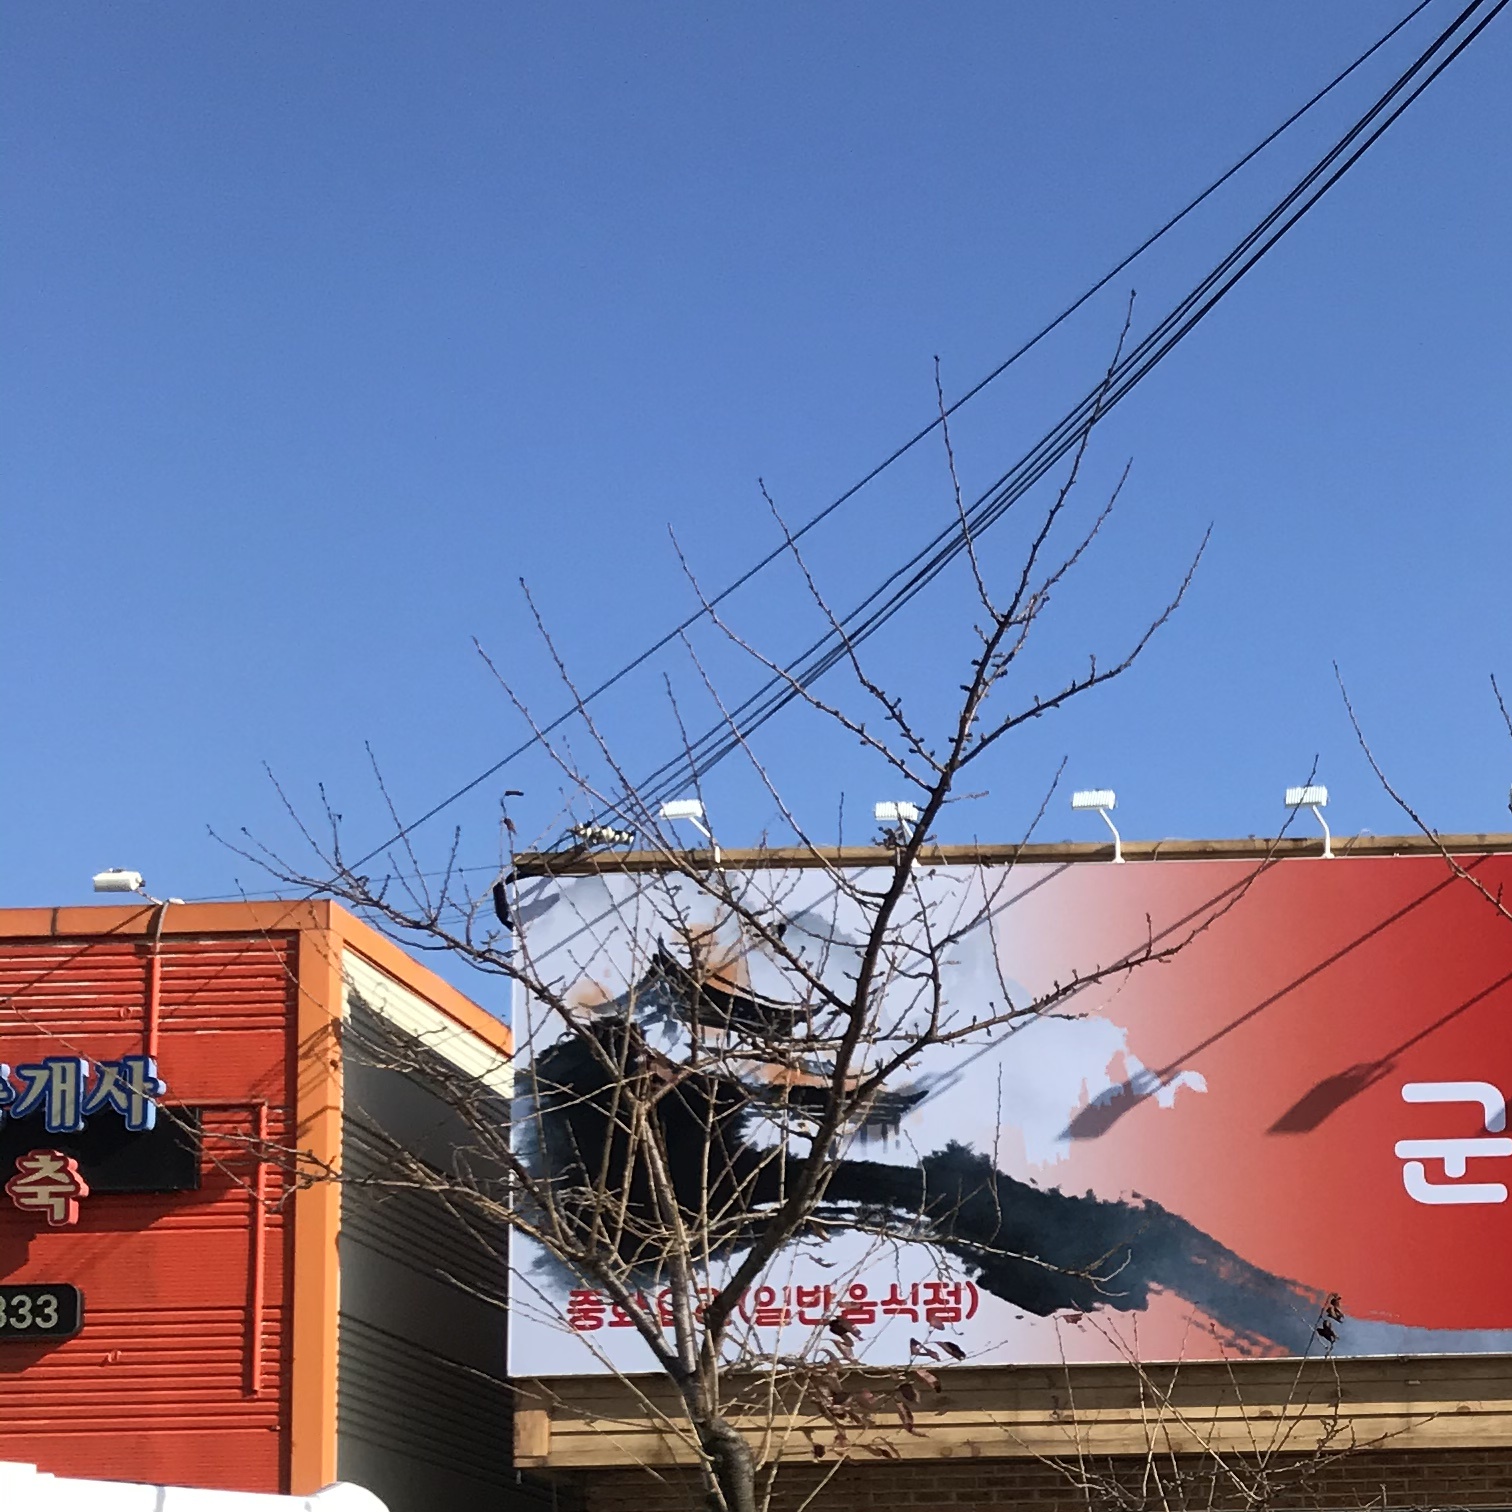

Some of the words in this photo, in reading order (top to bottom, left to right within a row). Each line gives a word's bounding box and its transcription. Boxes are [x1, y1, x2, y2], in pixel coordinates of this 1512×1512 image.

[0, 1055, 162, 1132] 개사
[5, 1150, 86, 1226] 축
[0, 1293, 59, 1330] 33
